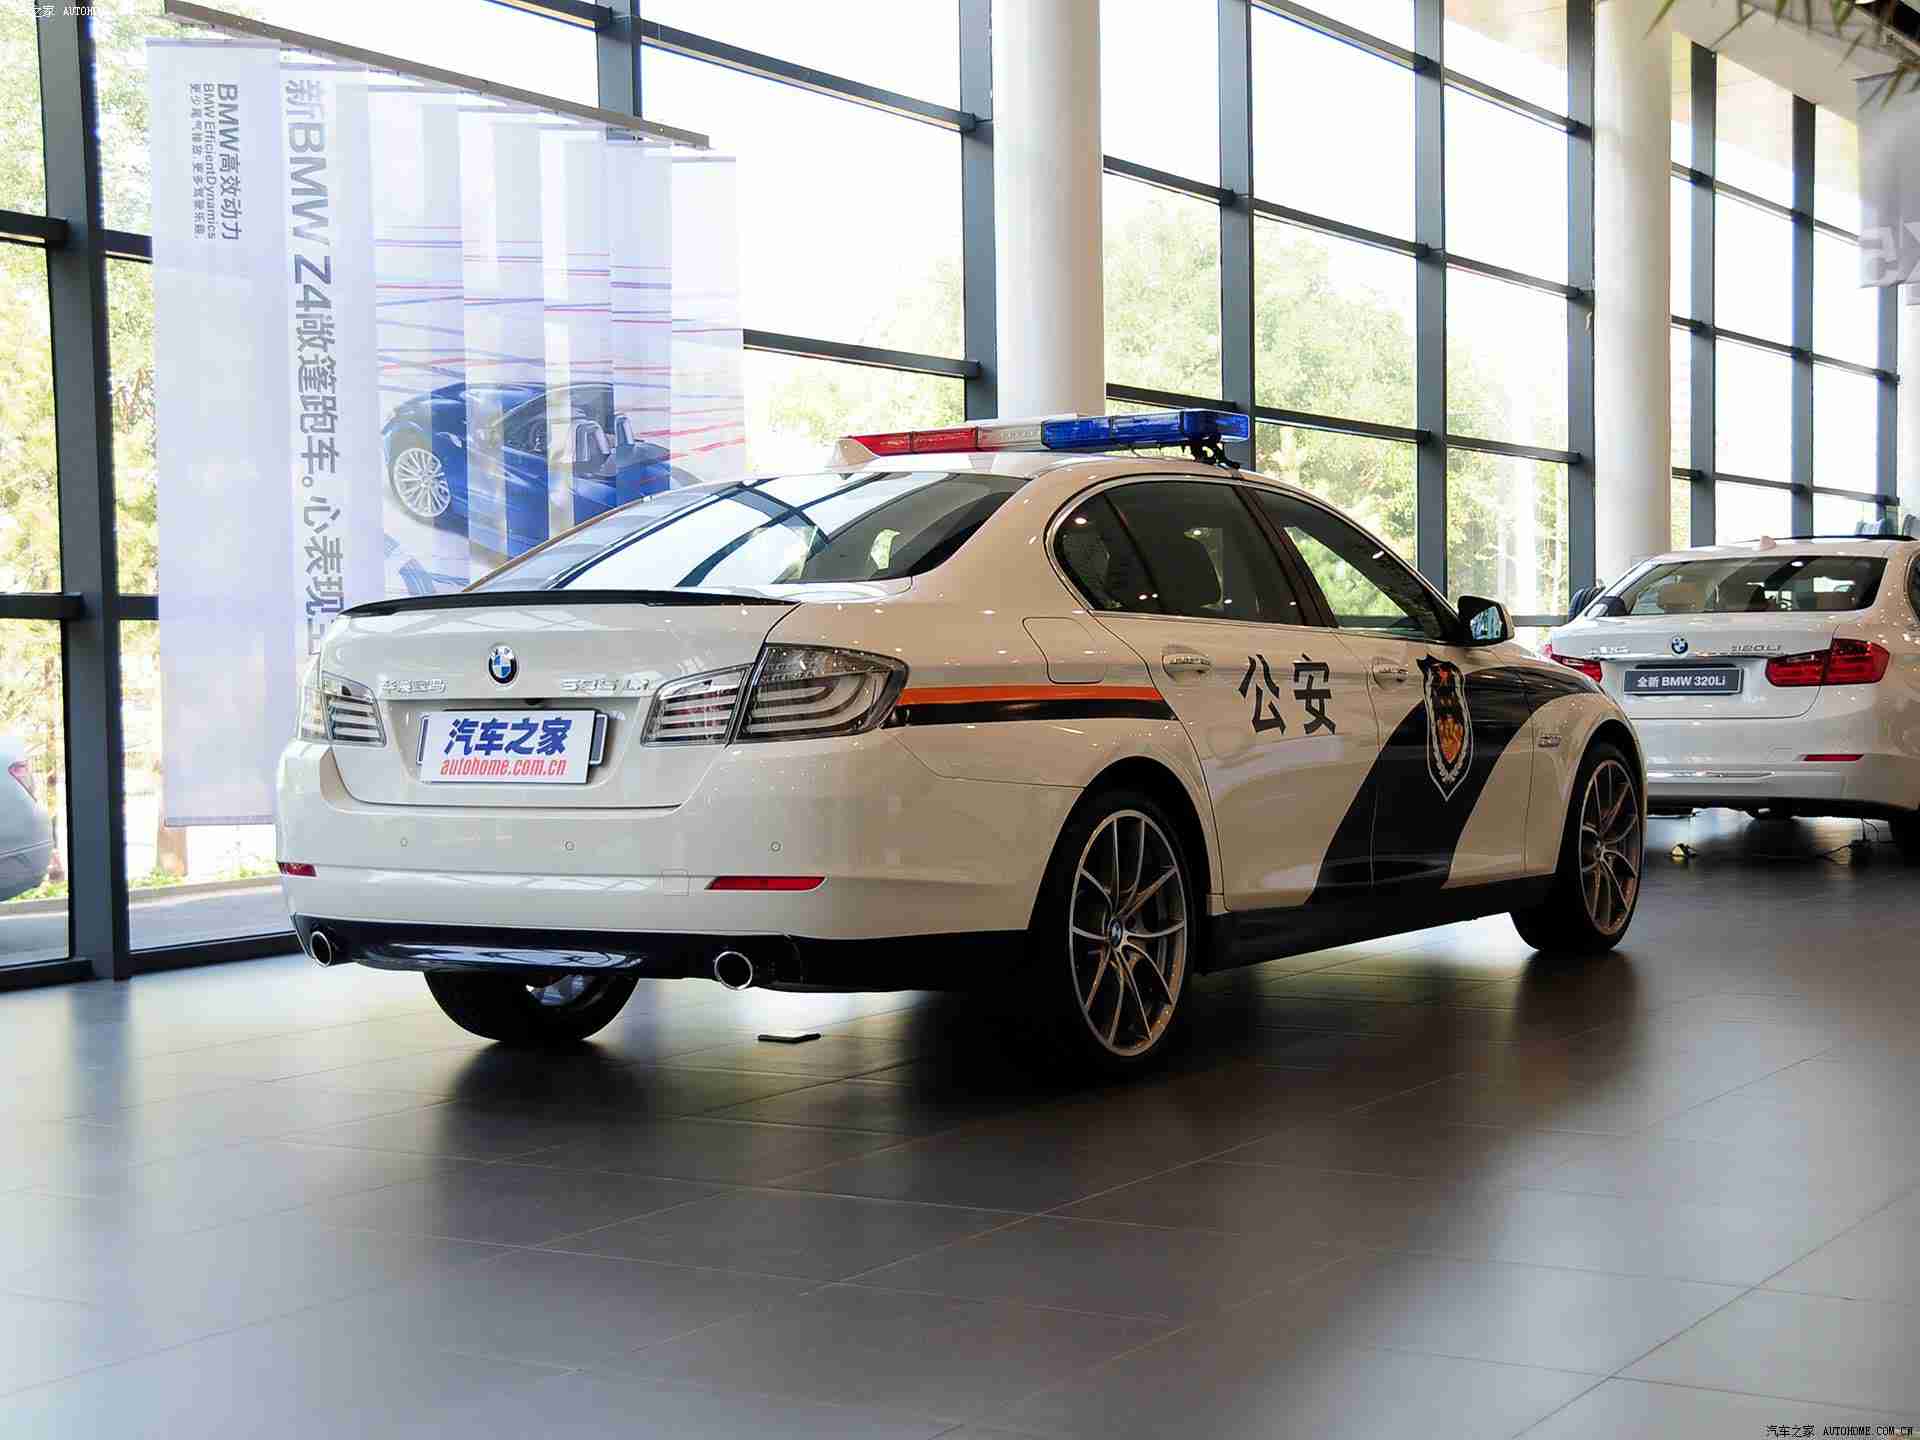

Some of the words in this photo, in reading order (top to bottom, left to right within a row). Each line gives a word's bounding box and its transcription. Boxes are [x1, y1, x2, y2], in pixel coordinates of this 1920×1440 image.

[203, 83, 216, 118] BMW
[204, 121, 217, 239] EfficientDynamics
[217, 84, 242, 240] BMW高效动力
[285, 80, 330, 247] 新BMW
[1238, 653, 1335, 736] 公安
[1661, 676, 1692, 687] BMW
[1695, 675, 1726, 687] 320Li
[440, 756, 568, 776] autohome.com.cn
[443, 717, 573, 756] 汽车之家
